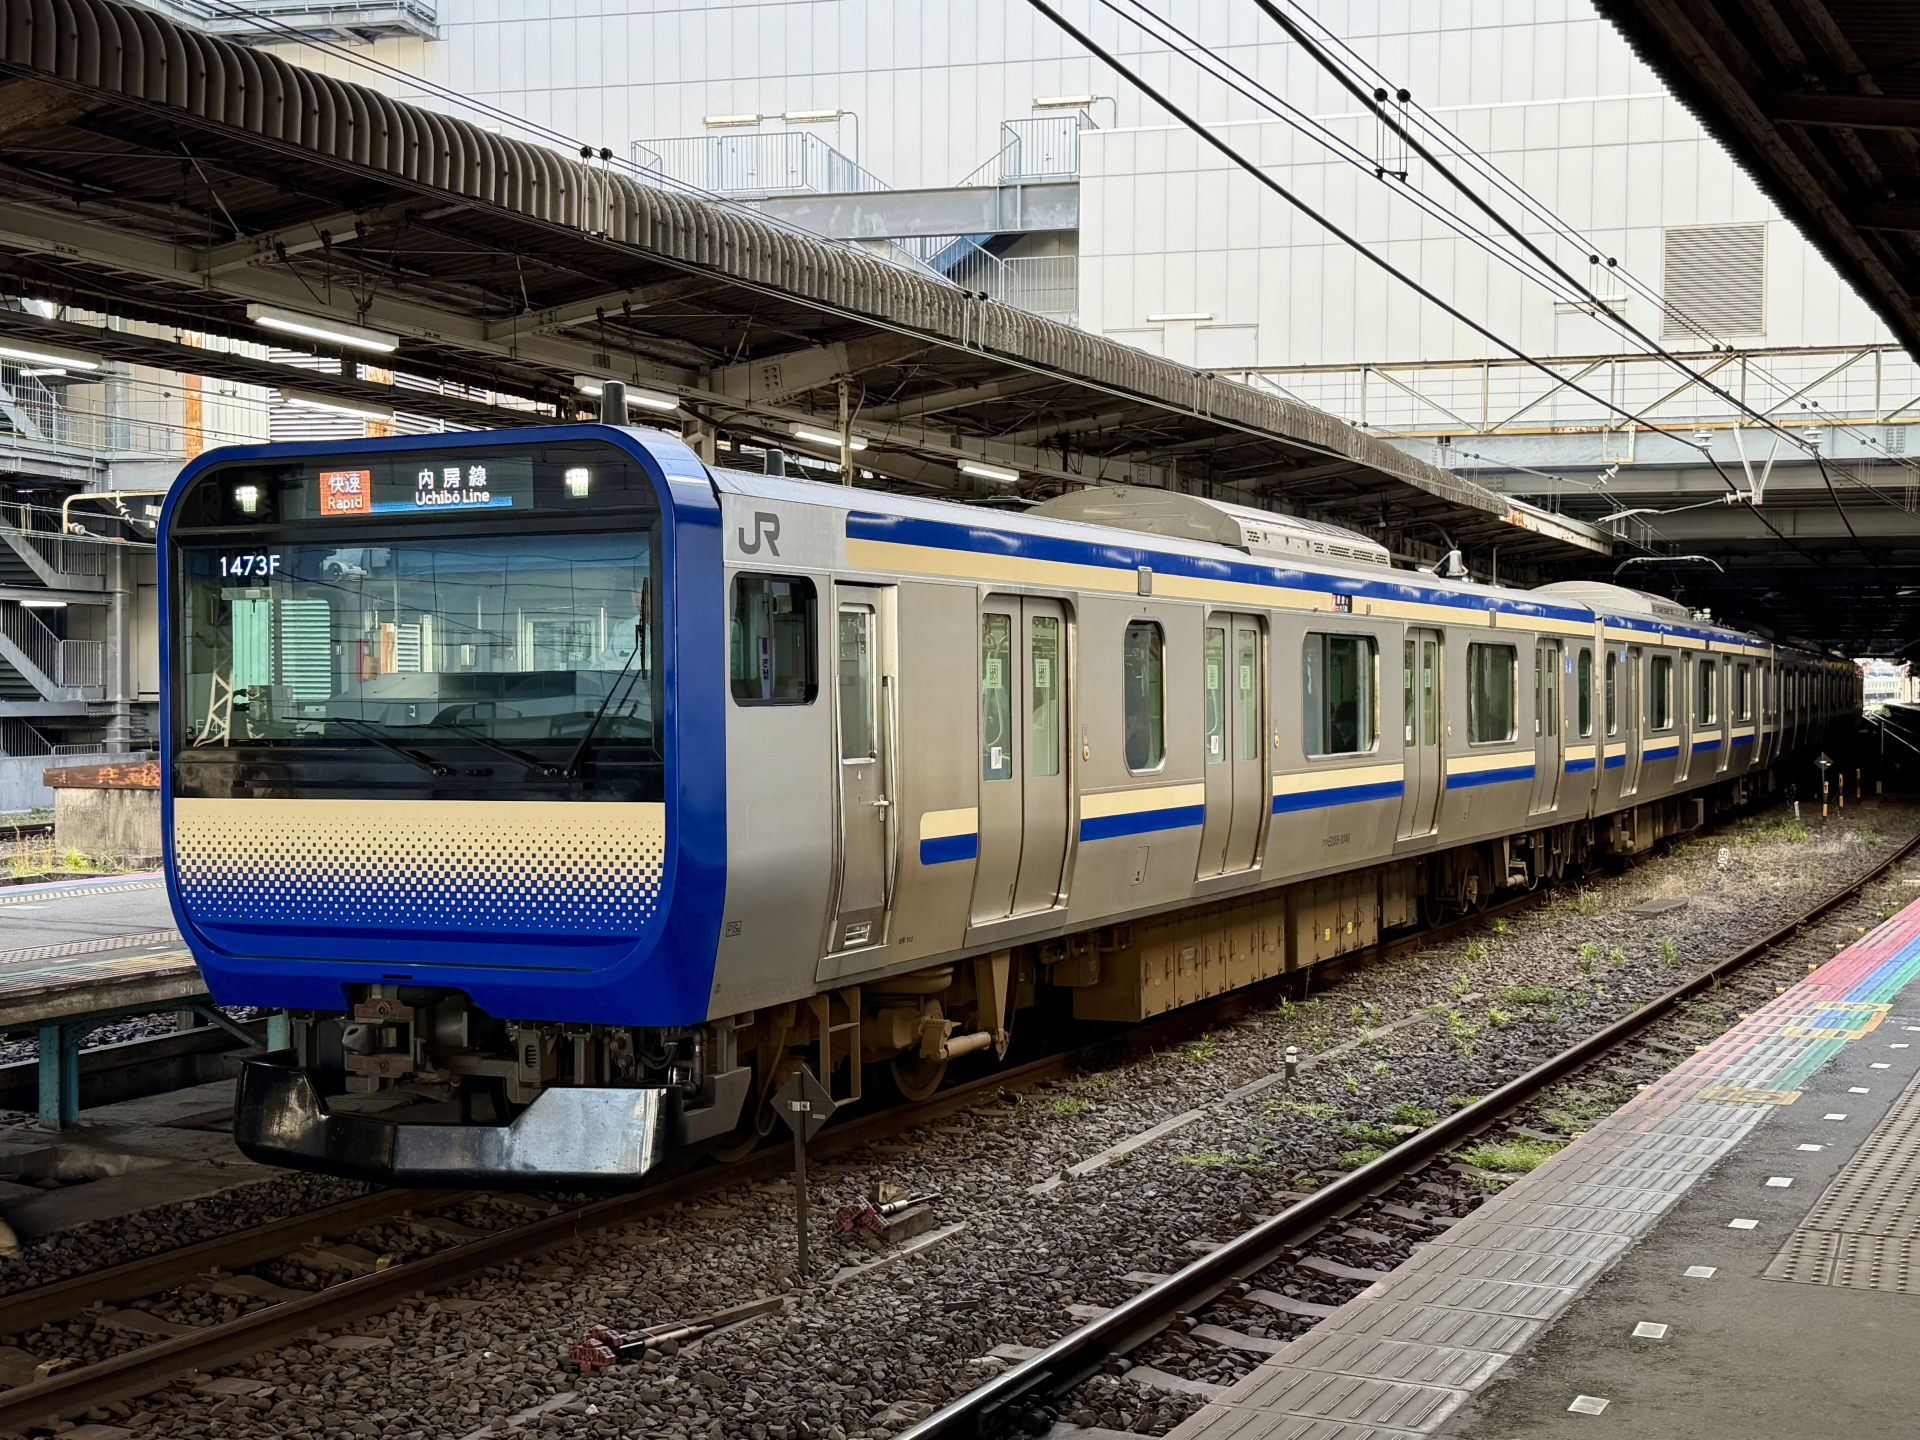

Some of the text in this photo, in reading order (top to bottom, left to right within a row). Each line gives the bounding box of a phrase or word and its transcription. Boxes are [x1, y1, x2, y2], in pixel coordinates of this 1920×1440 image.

[328, 473, 362, 494] 快速
[418, 465, 487, 490] 内房線
[328, 495, 363, 514] Rapid
[415, 488, 490, 506] Uchibō Line
[738, 511, 781, 557] JR
[220, 554, 280, 577] 1473F
